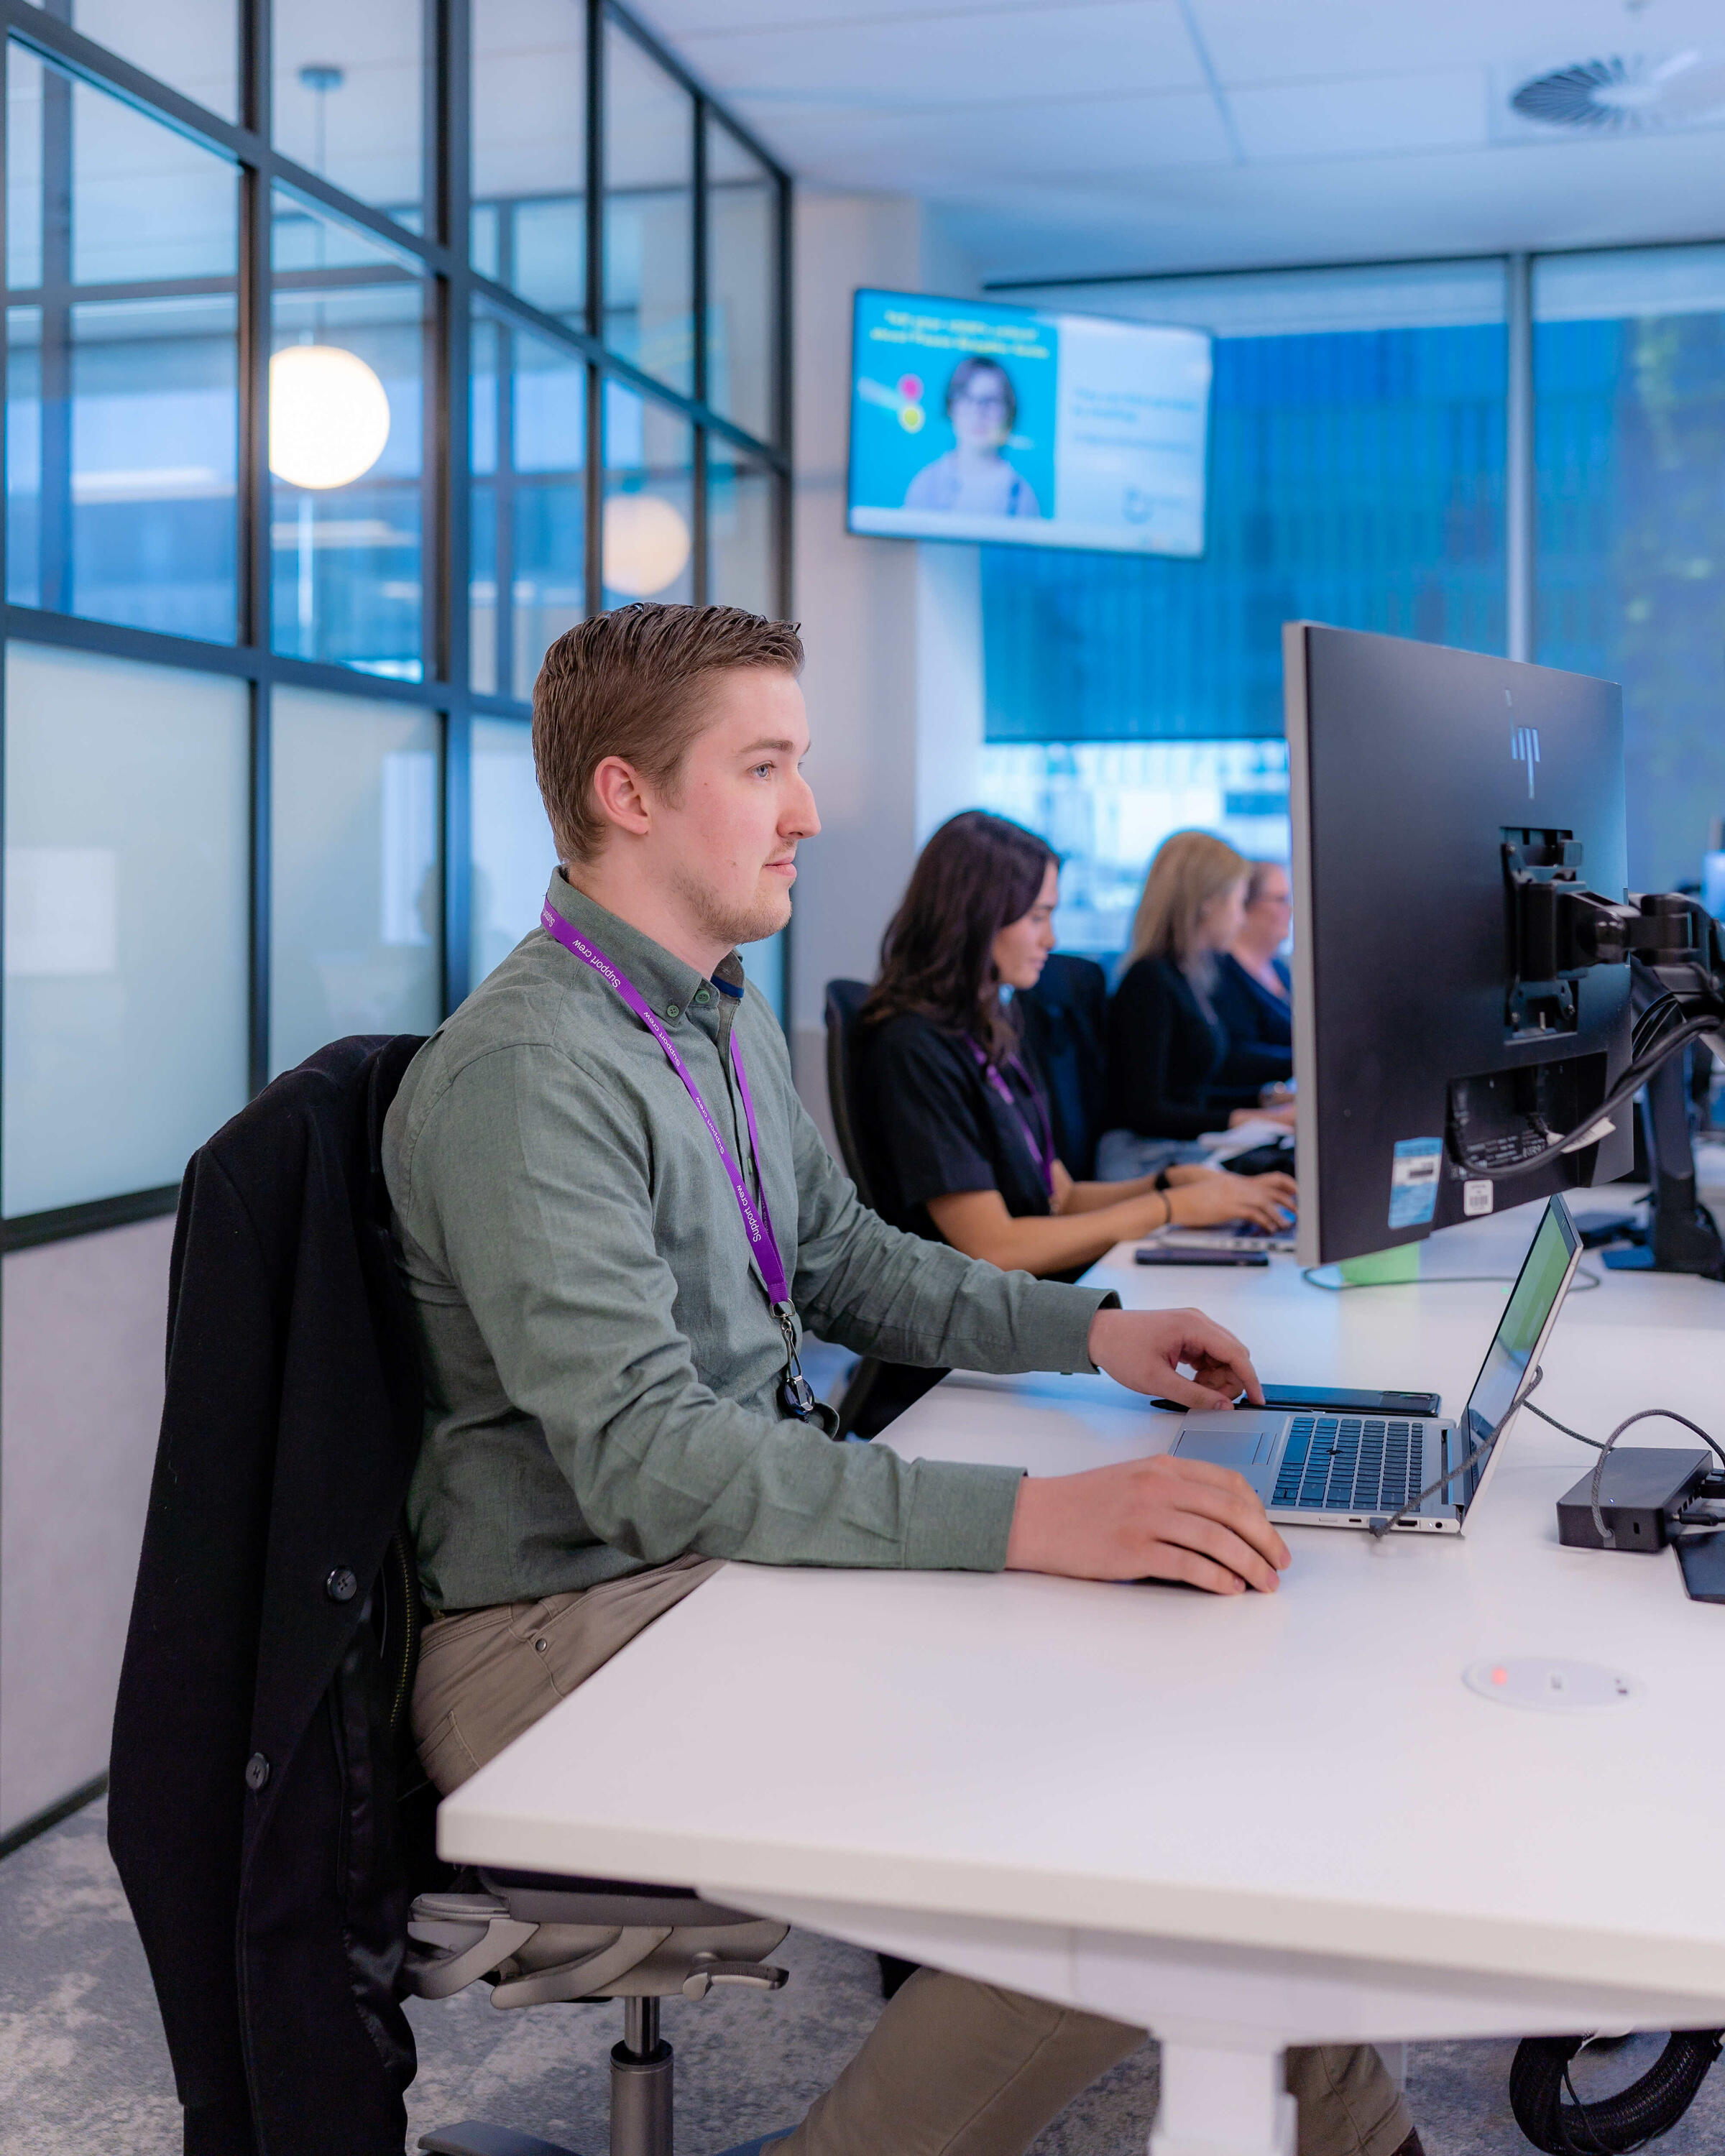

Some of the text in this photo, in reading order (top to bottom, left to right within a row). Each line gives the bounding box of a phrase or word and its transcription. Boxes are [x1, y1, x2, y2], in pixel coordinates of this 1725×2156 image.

[572, 939, 621, 988] Support crew
[643, 1011, 681, 1067] Support crew
[696, 1097, 725, 1154] Support crew
[737, 1184, 762, 1243] Support crew
